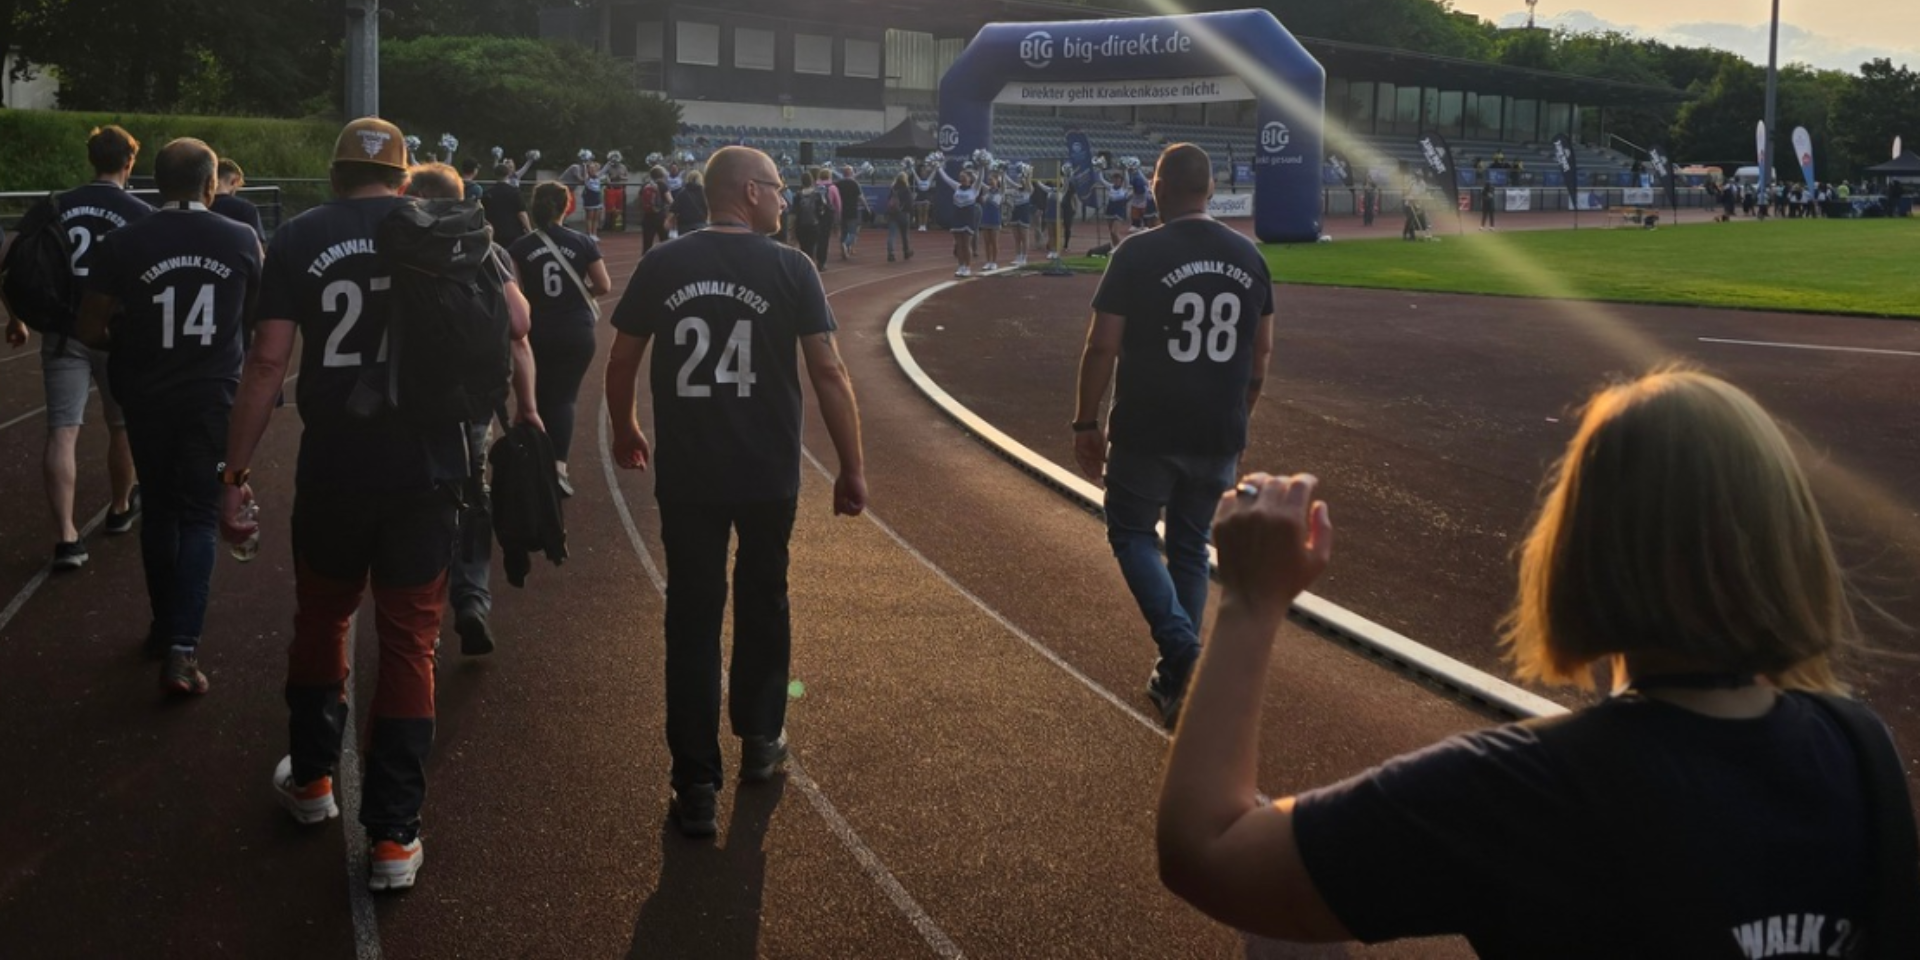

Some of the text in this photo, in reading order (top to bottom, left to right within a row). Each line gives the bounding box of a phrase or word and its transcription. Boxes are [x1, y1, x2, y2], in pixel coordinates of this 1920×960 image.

[1020, 30, 1191, 64] BIG big-direkt.de
[1021, 82, 1220, 102] Direkter geht Krankenkasse nicht.
[939, 130, 959, 146] BIG
[1261, 127, 1290, 146] BIG
[68, 225, 105, 276] 2
[307, 238, 377, 278] TEAMWAL
[139, 255, 233, 284] TEAMWALK 2025
[542, 260, 563, 298] 6
[1160, 259, 1254, 290] TEAMWALK 2025
[663, 280, 771, 315] TEAMWALK 2025
[152, 283, 217, 349] 14
[1167, 291, 1242, 363] 38
[673, 316, 757, 398] 24
[1731, 912, 1826, 960] WALK
